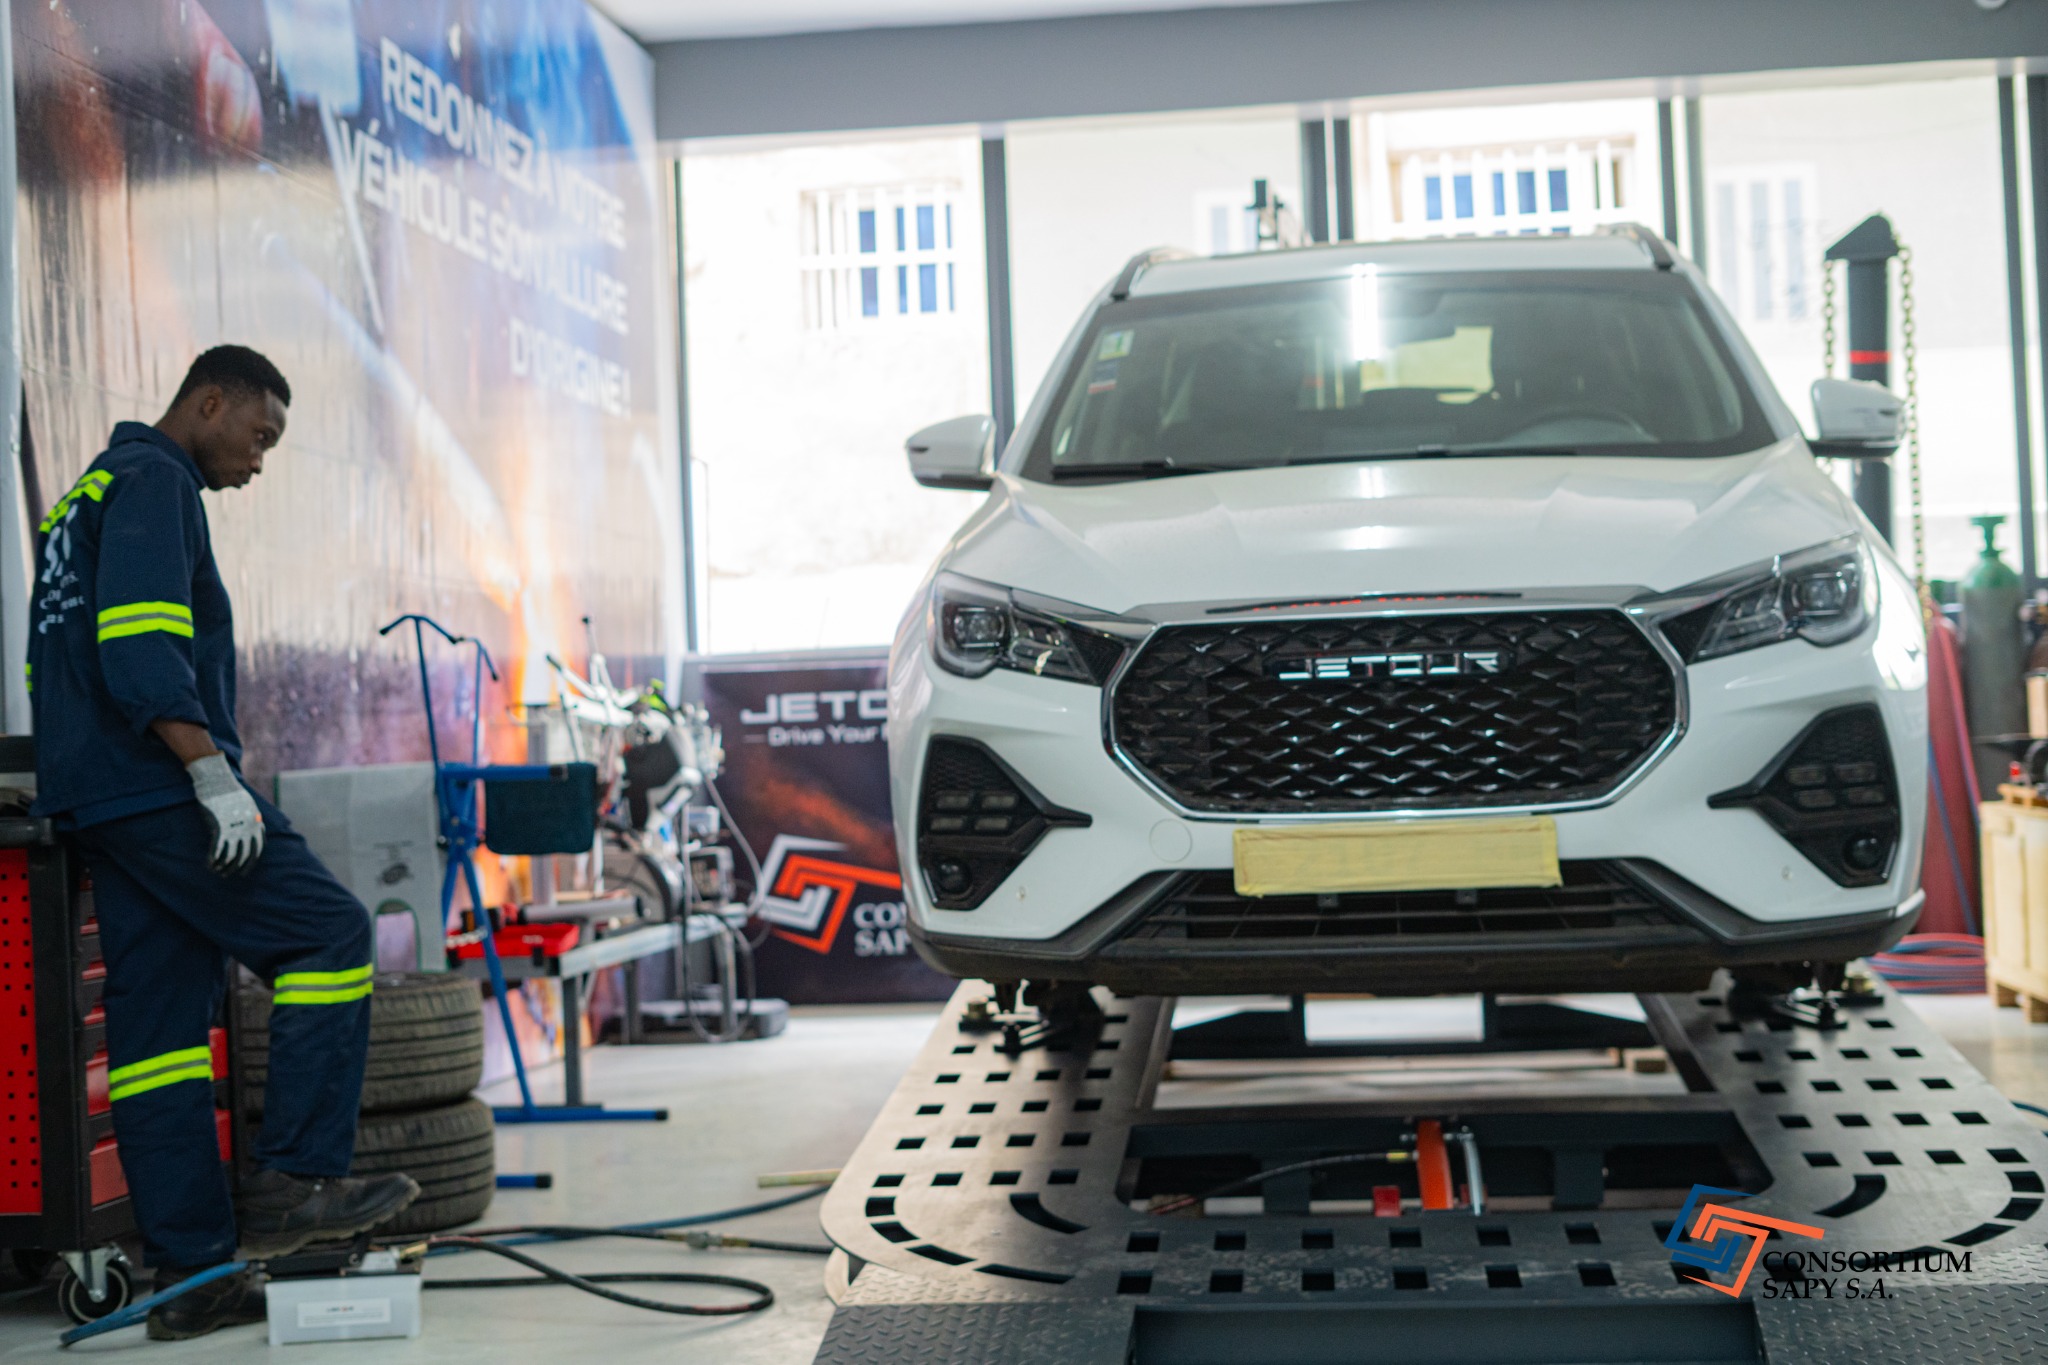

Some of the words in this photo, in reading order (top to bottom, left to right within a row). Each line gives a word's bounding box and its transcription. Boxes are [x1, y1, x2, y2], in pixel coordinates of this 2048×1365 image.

[380, 36, 534, 193] REDONNEZ
[340, 117, 487, 262] VÉHICULE
[1278, 652, 1499, 680] JETOUR
[768, 726, 825, 747] Drive
[827, 724, 879, 744] Your
